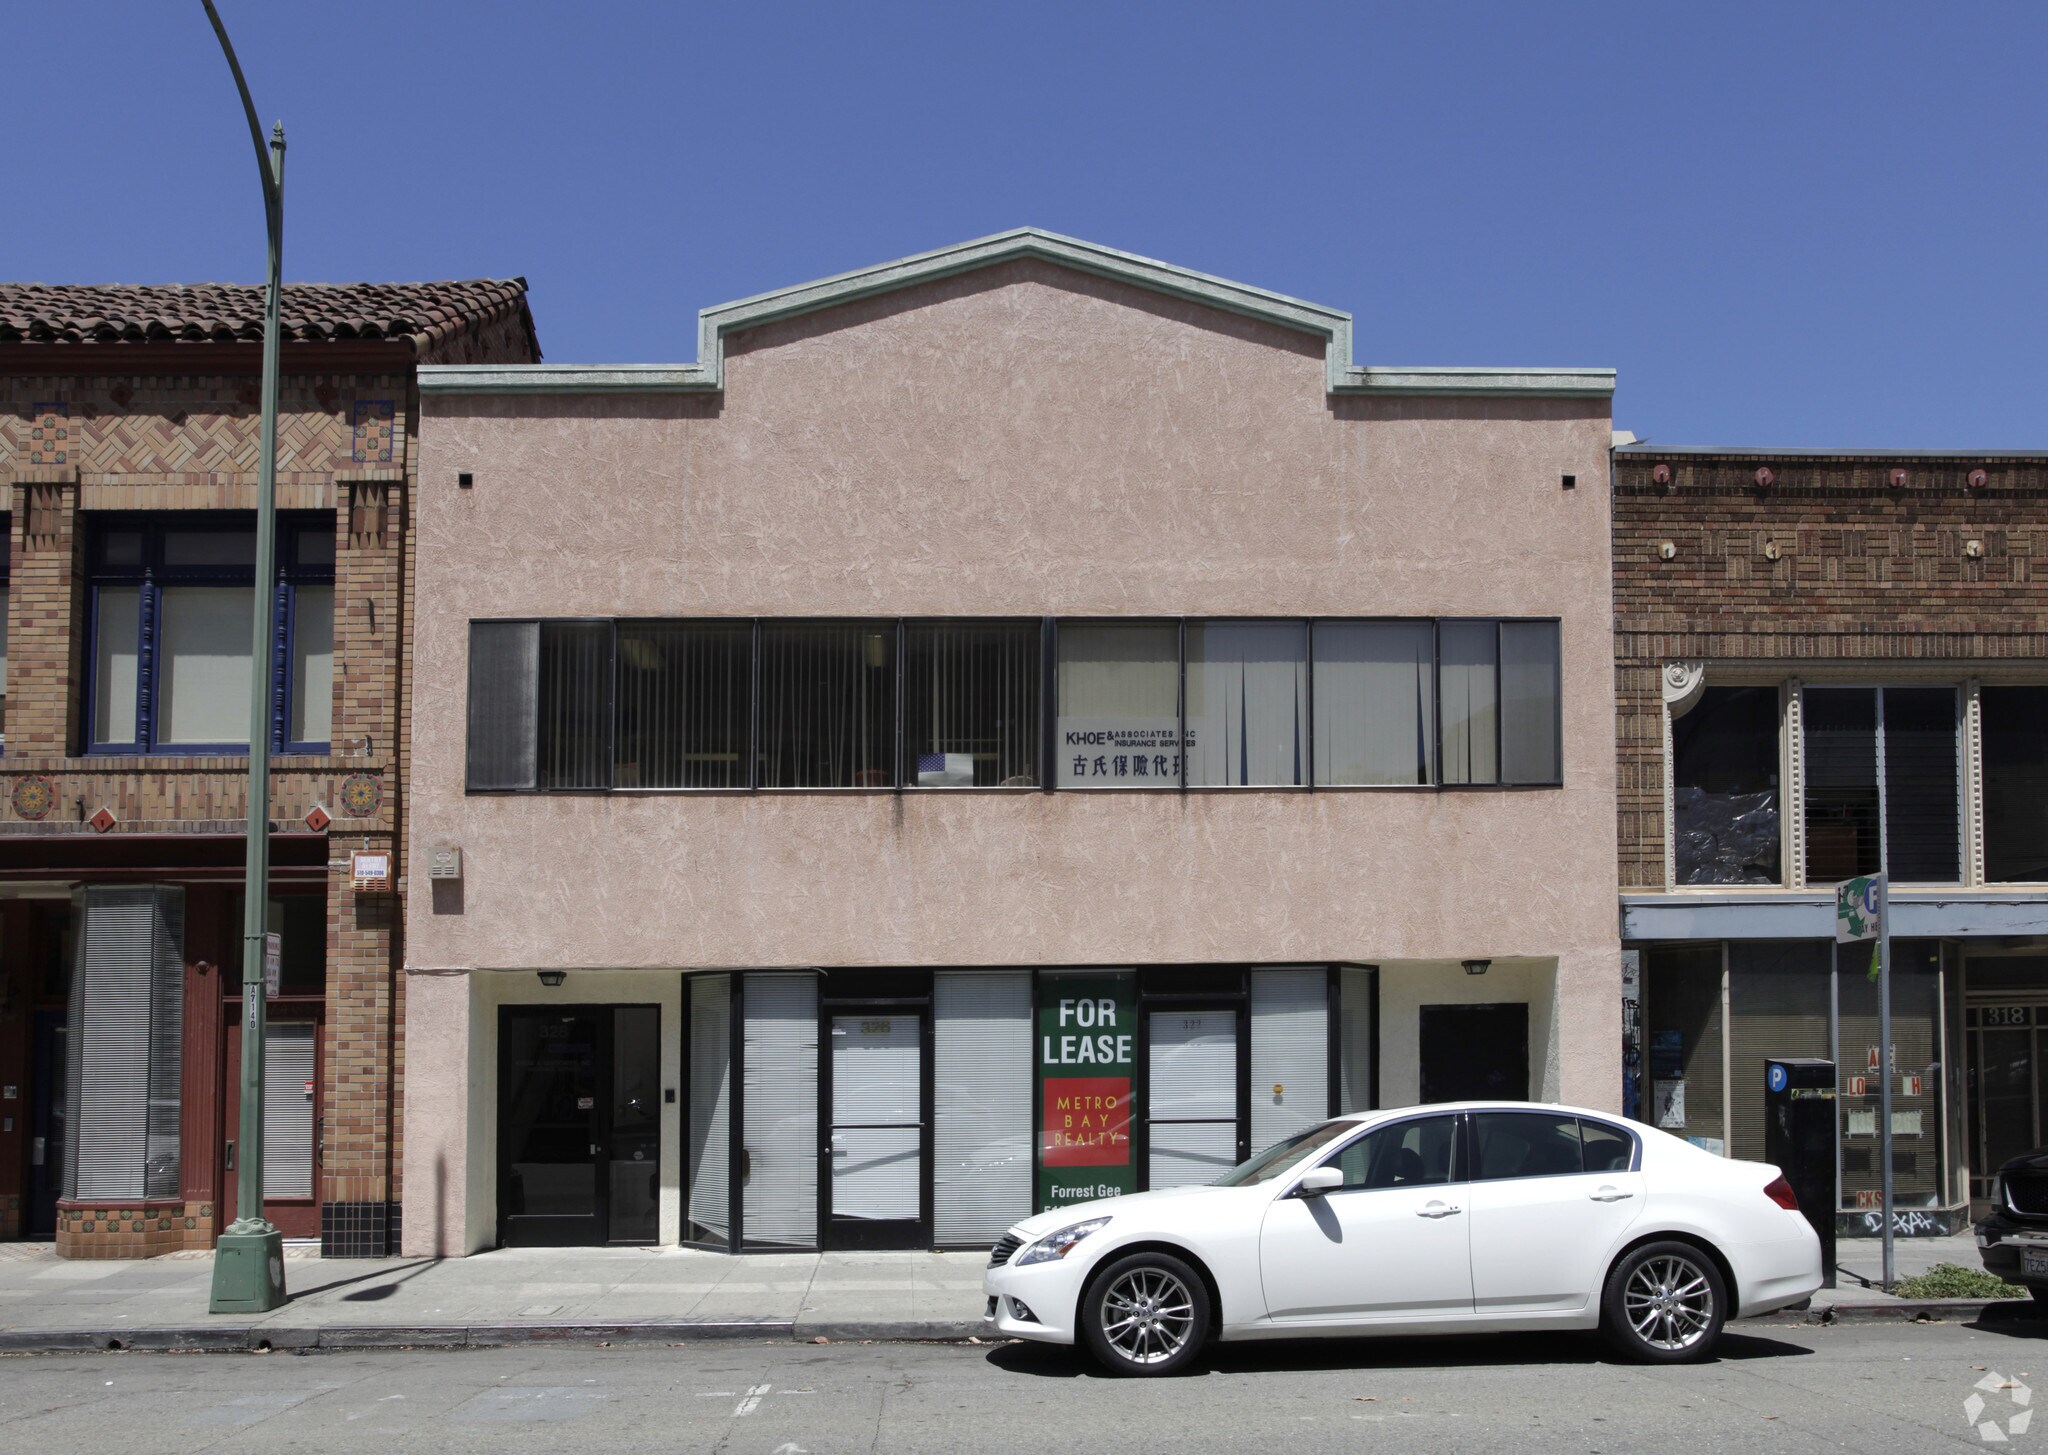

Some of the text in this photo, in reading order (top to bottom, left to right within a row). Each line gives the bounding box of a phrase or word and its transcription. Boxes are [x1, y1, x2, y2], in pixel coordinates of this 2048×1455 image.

[1066, 732, 1106, 745] KHOE
[1107, 731, 1114, 740] &
[1115, 730, 1174, 738] ASSOCIATES
[1059, 999, 1116, 1027] FOR
[1989, 1007, 2024, 1024] 318
[1043, 1035, 1132, 1064] LEASE
[1772, 1068, 1783, 1088] P
[1057, 1096, 1118, 1110] METRO
[1064, 1115, 1109, 1128] BAY
[1055, 1132, 1118, 1146] REALTY
[1051, 1184, 1121, 1198] Forrest Gee
